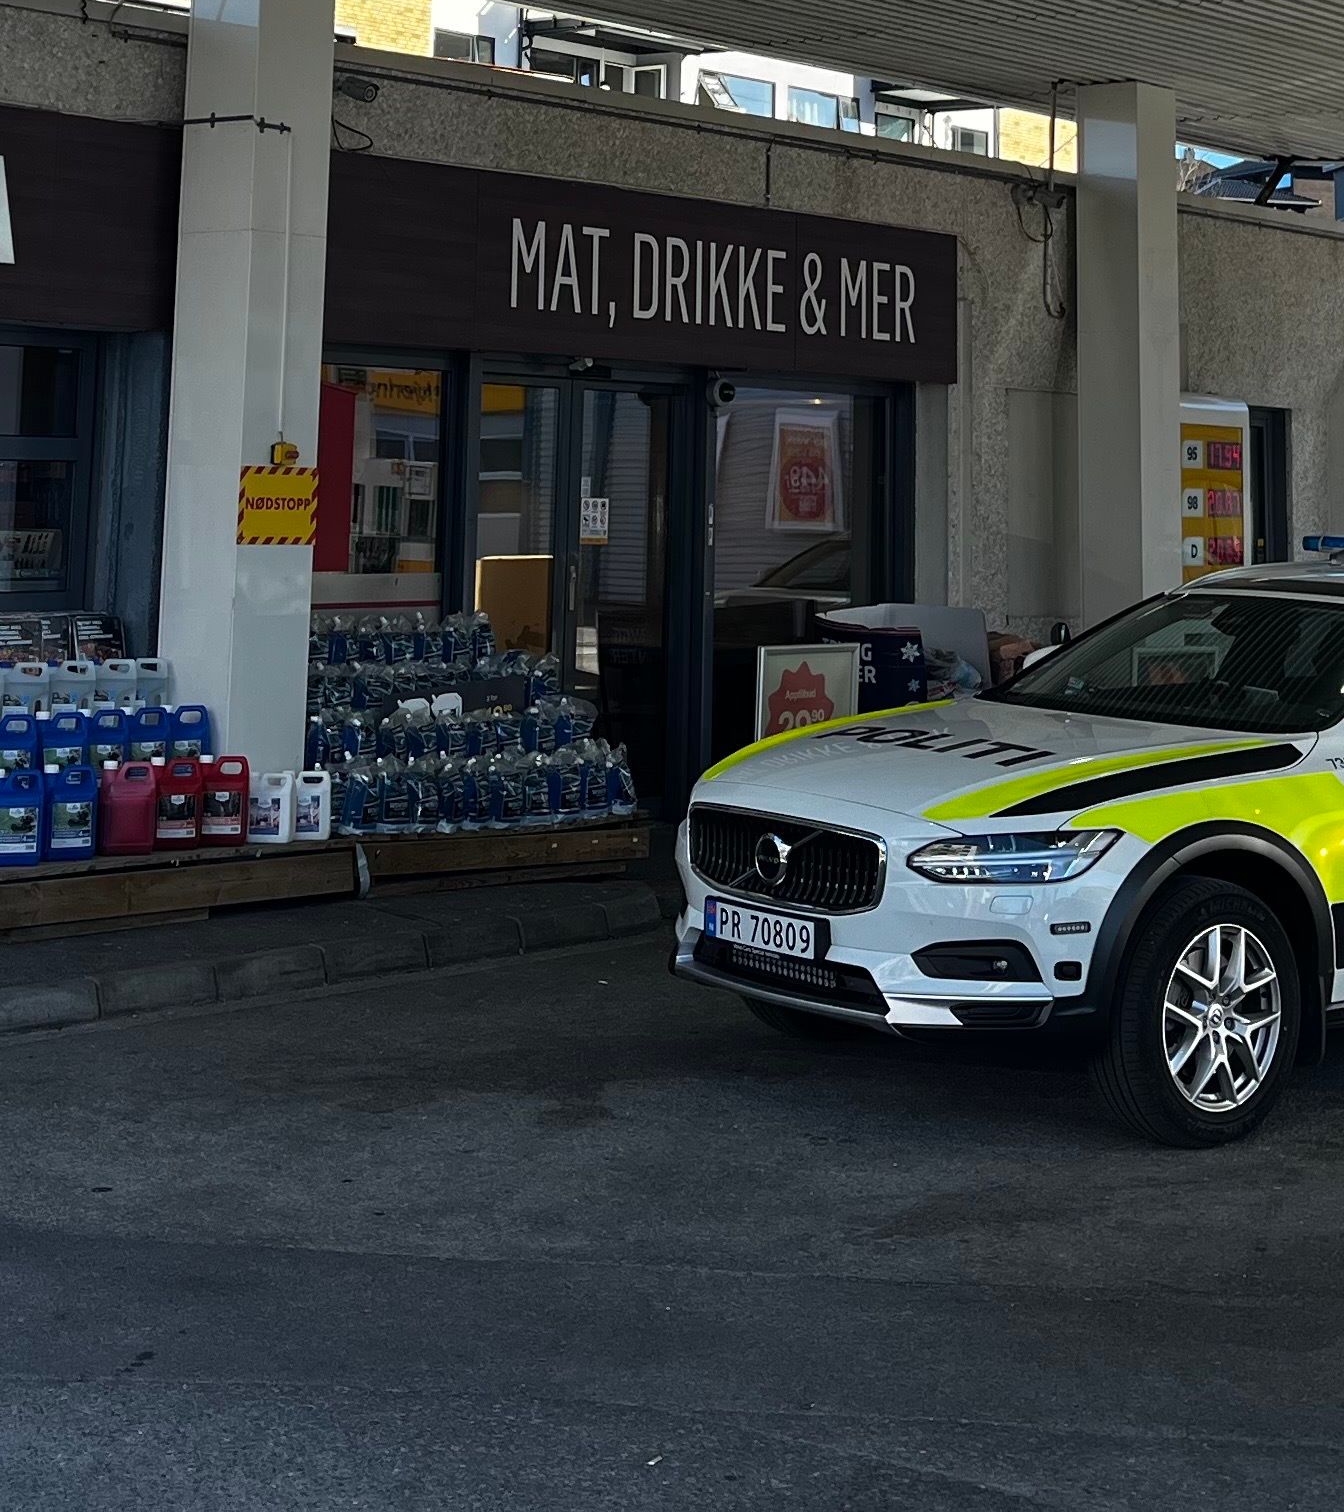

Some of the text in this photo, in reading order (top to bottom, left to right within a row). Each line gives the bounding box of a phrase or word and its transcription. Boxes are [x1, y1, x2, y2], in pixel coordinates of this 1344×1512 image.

[510, 218, 917, 344] MAT, DRIKKE & MER
[245, 497, 311, 511] NØDSTOPP
[1187, 496, 1198, 510] 98
[1191, 544, 1198, 558] D
[813, 726, 1056, 767] POLITI
[719, 907, 741, 939] PR
[750, 914, 810, 954] 70809
